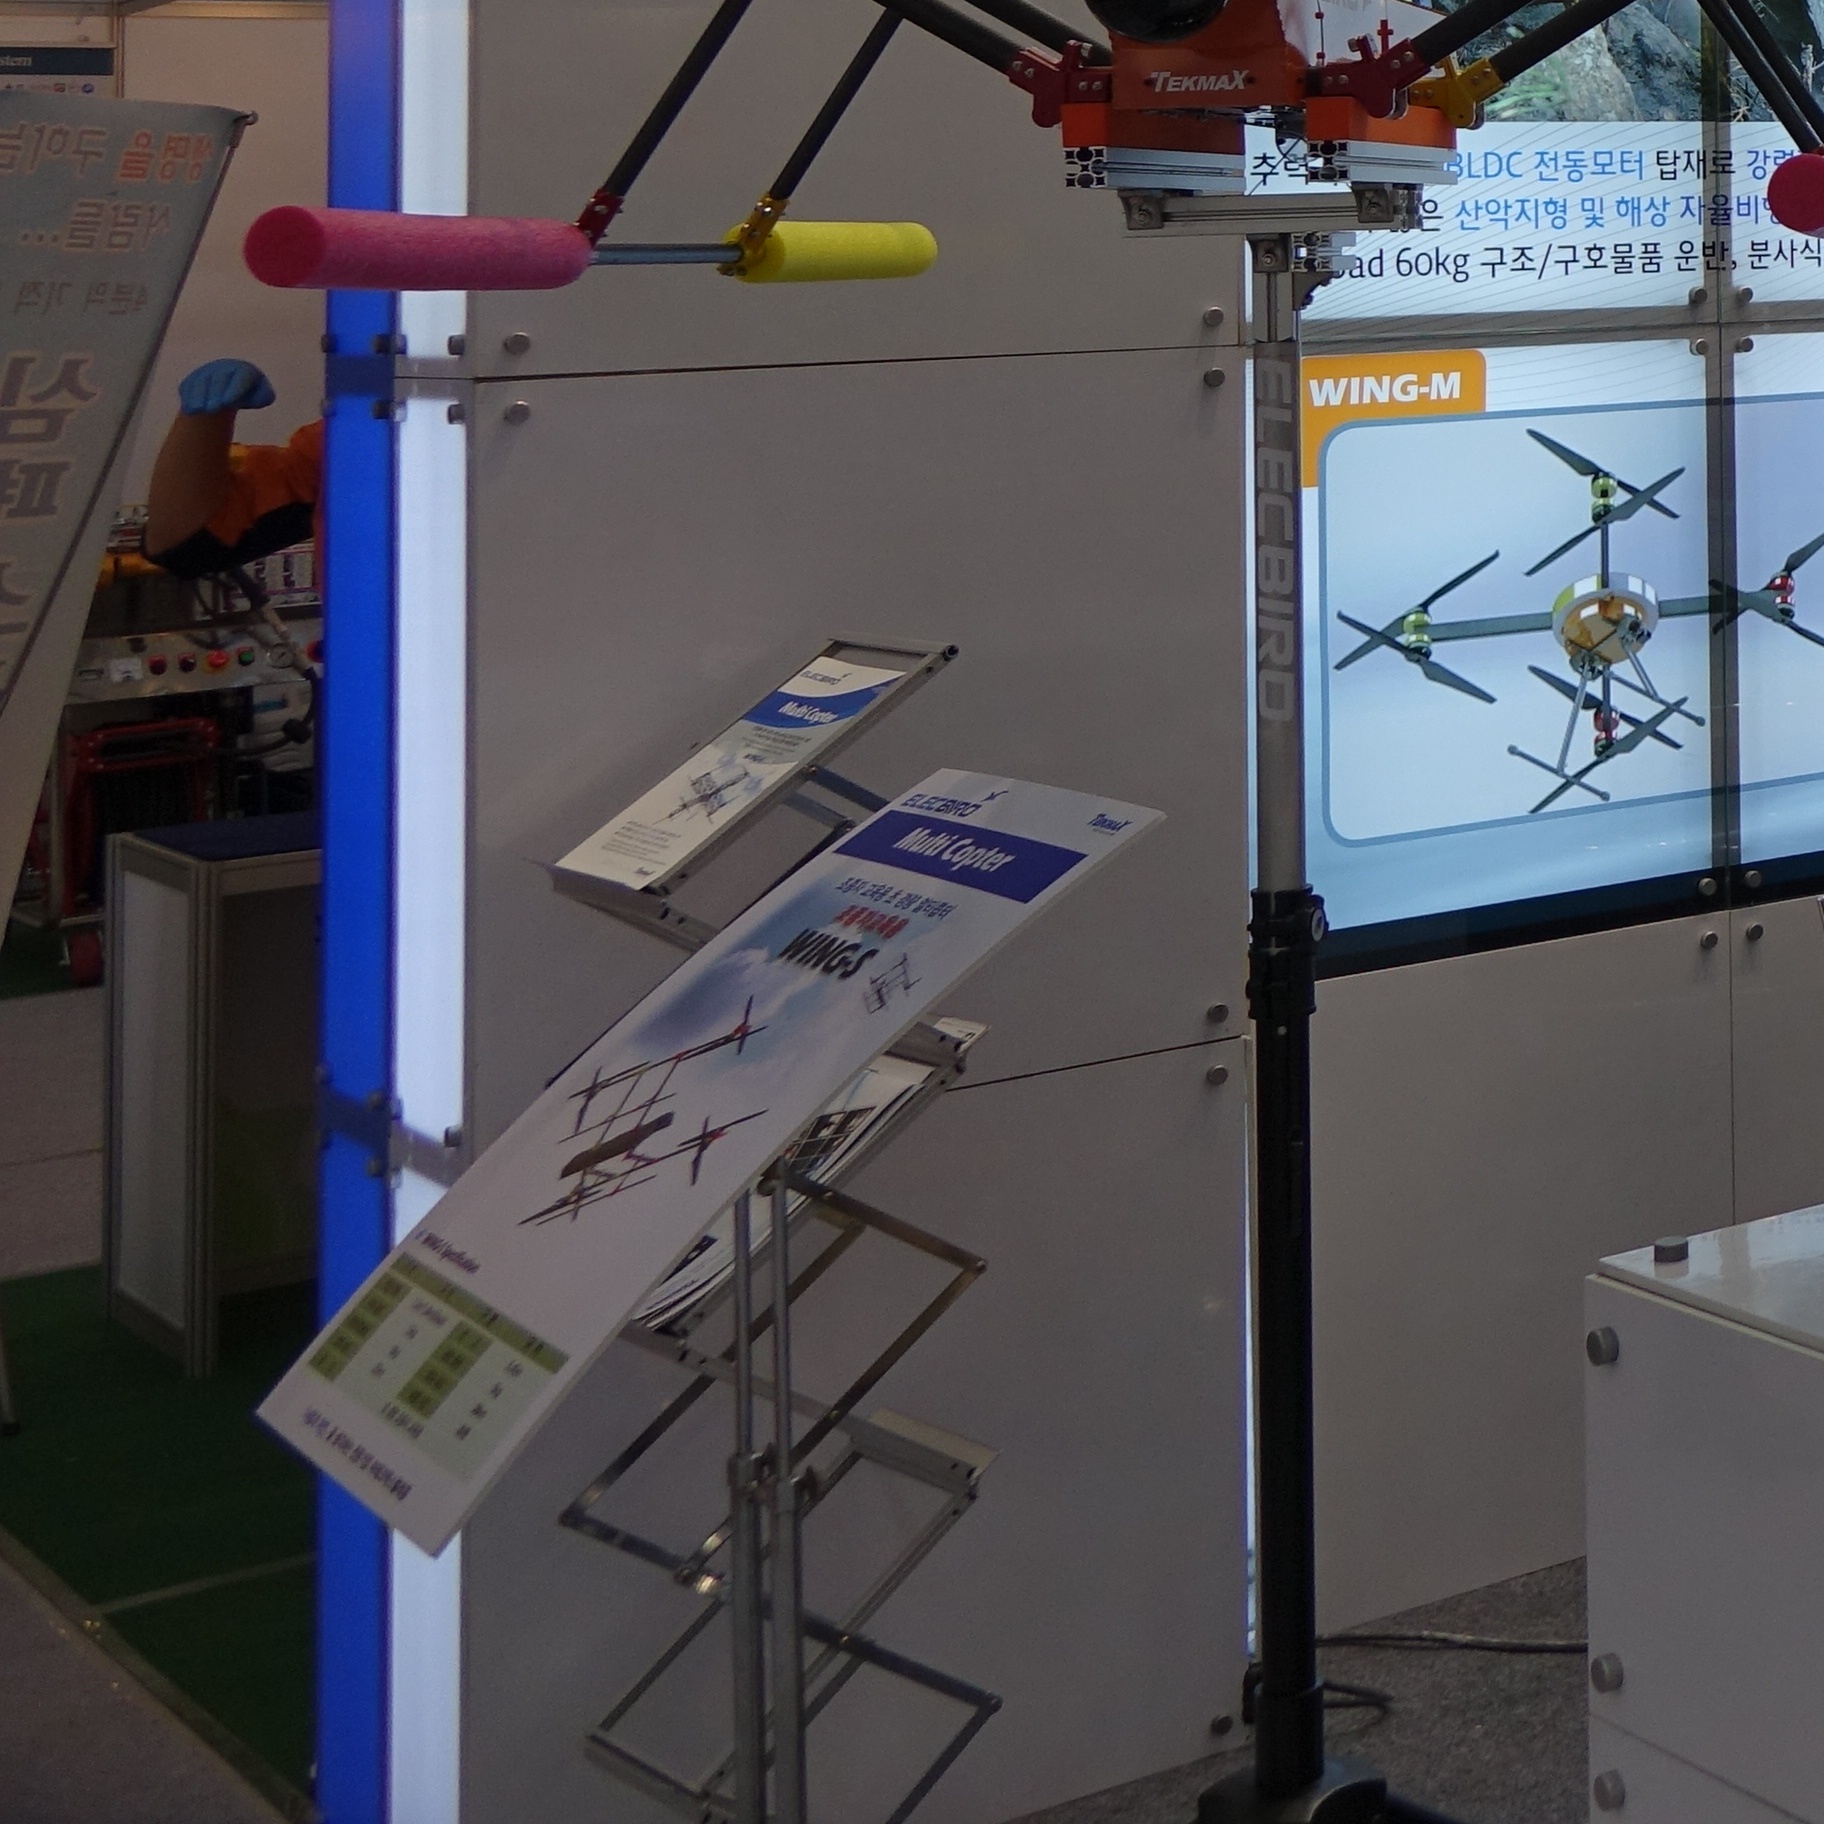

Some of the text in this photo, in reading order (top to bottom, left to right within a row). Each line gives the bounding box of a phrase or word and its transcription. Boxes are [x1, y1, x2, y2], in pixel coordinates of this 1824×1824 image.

[1149, 69, 1250, 93] TEKMAX
[1534, 149, 1644, 183] 전동모터
[1656, 149, 1737, 180] 탑재로
[1454, 195, 1568, 232] 산악지형
[1580, 196, 1605, 229] 및
[1615, 194, 1671, 228] 해상
[1395, 246, 1470, 284] 60kg
[1480, 242, 1664, 280] 구조/구호물품
[1674, 239, 1738, 273] 운반,
[1747, 238, 1822, 271] 분사식
[1308, 371, 1462, 408] WING-M
[1255, 355, 1298, 723] ELECBIRD
[892, 827, 1016, 873] Multi Copter
[776, 926, 880, 981] WING-S
